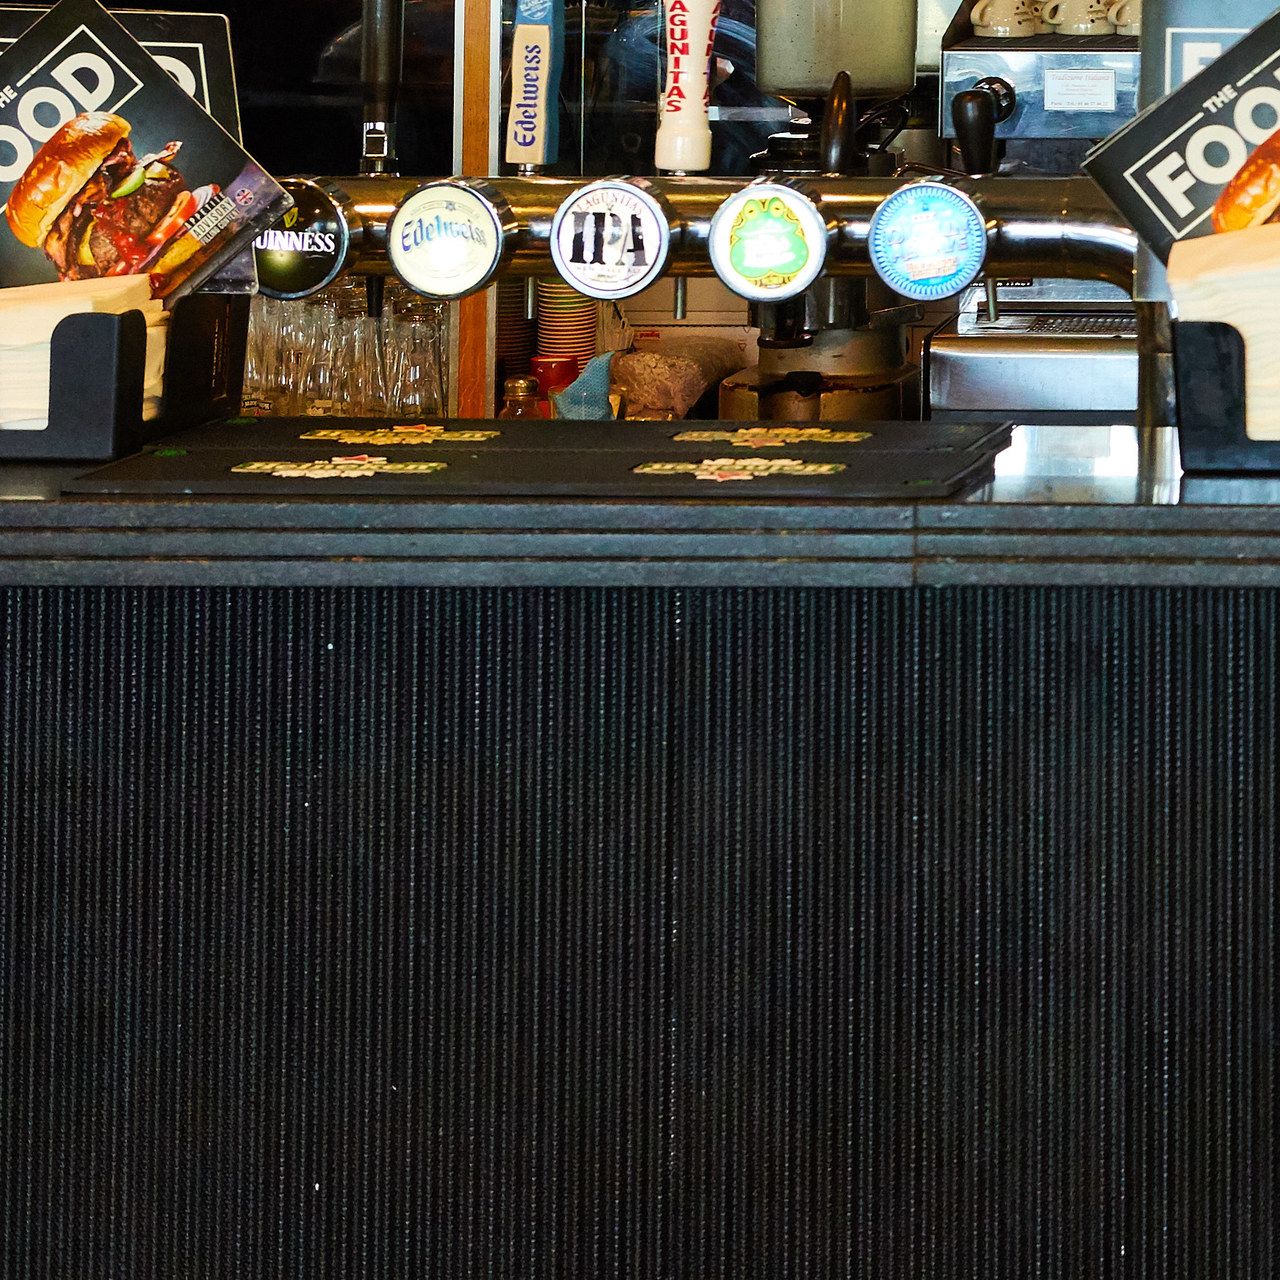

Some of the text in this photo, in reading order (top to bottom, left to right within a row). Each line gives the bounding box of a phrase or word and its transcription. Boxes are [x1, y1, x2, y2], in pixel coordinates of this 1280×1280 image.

[0, 84, 18, 109] HE
[513, 43, 543, 148] Edelweiss
[1203, 82, 1238, 115] THE
[192, 200, 234, 238] ADVISORY
[402, 214, 488, 252] Edelweiss
[252, 230, 335, 253] UINNESS
[569, 211, 649, 267] IPA
